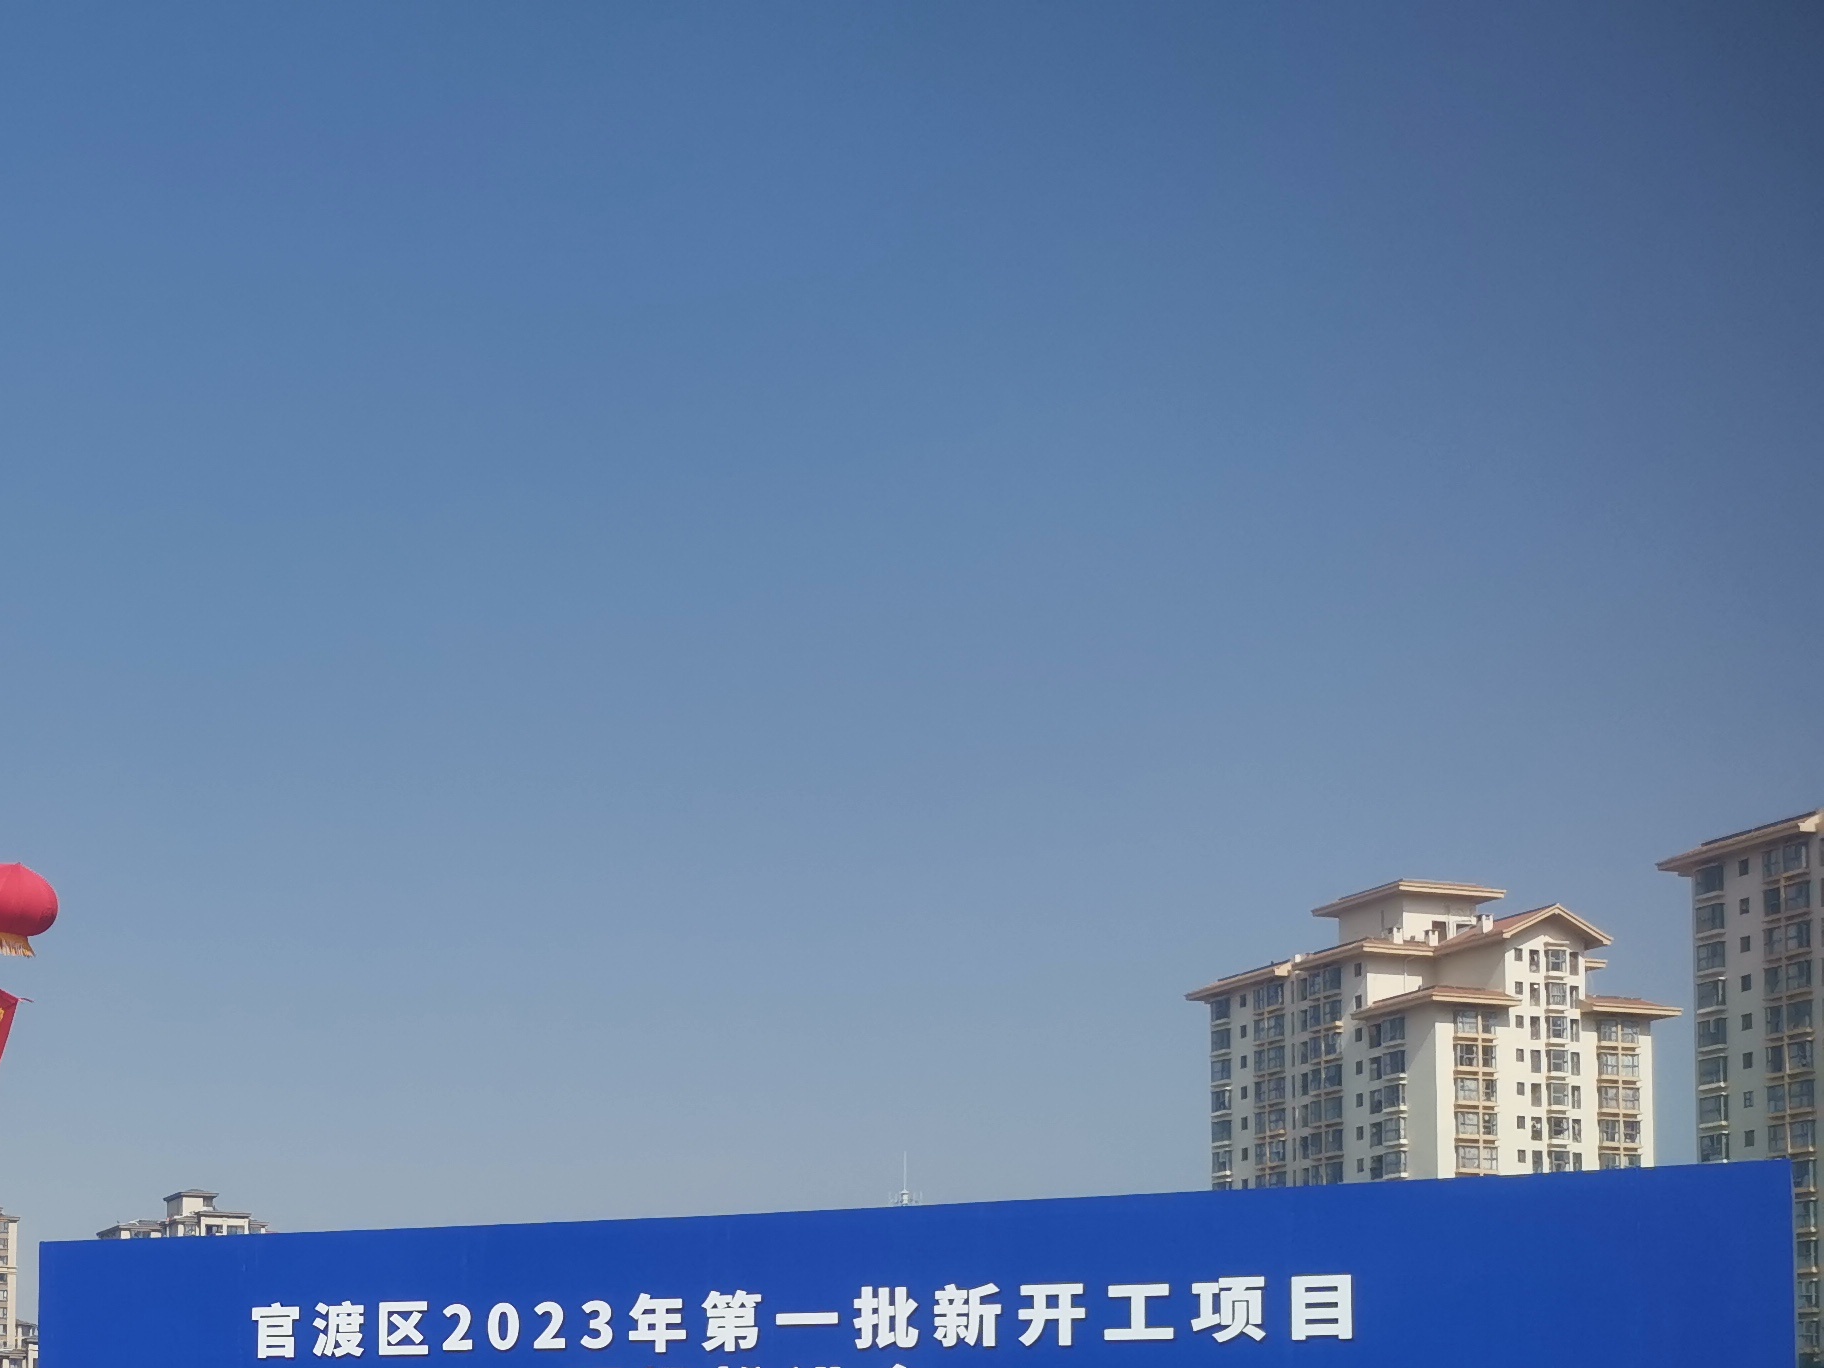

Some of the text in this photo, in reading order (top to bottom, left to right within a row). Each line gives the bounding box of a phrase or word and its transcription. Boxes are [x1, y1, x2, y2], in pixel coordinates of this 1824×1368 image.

[251, 1273, 1354, 1359] 官渡区2023年第一批新开工项目
